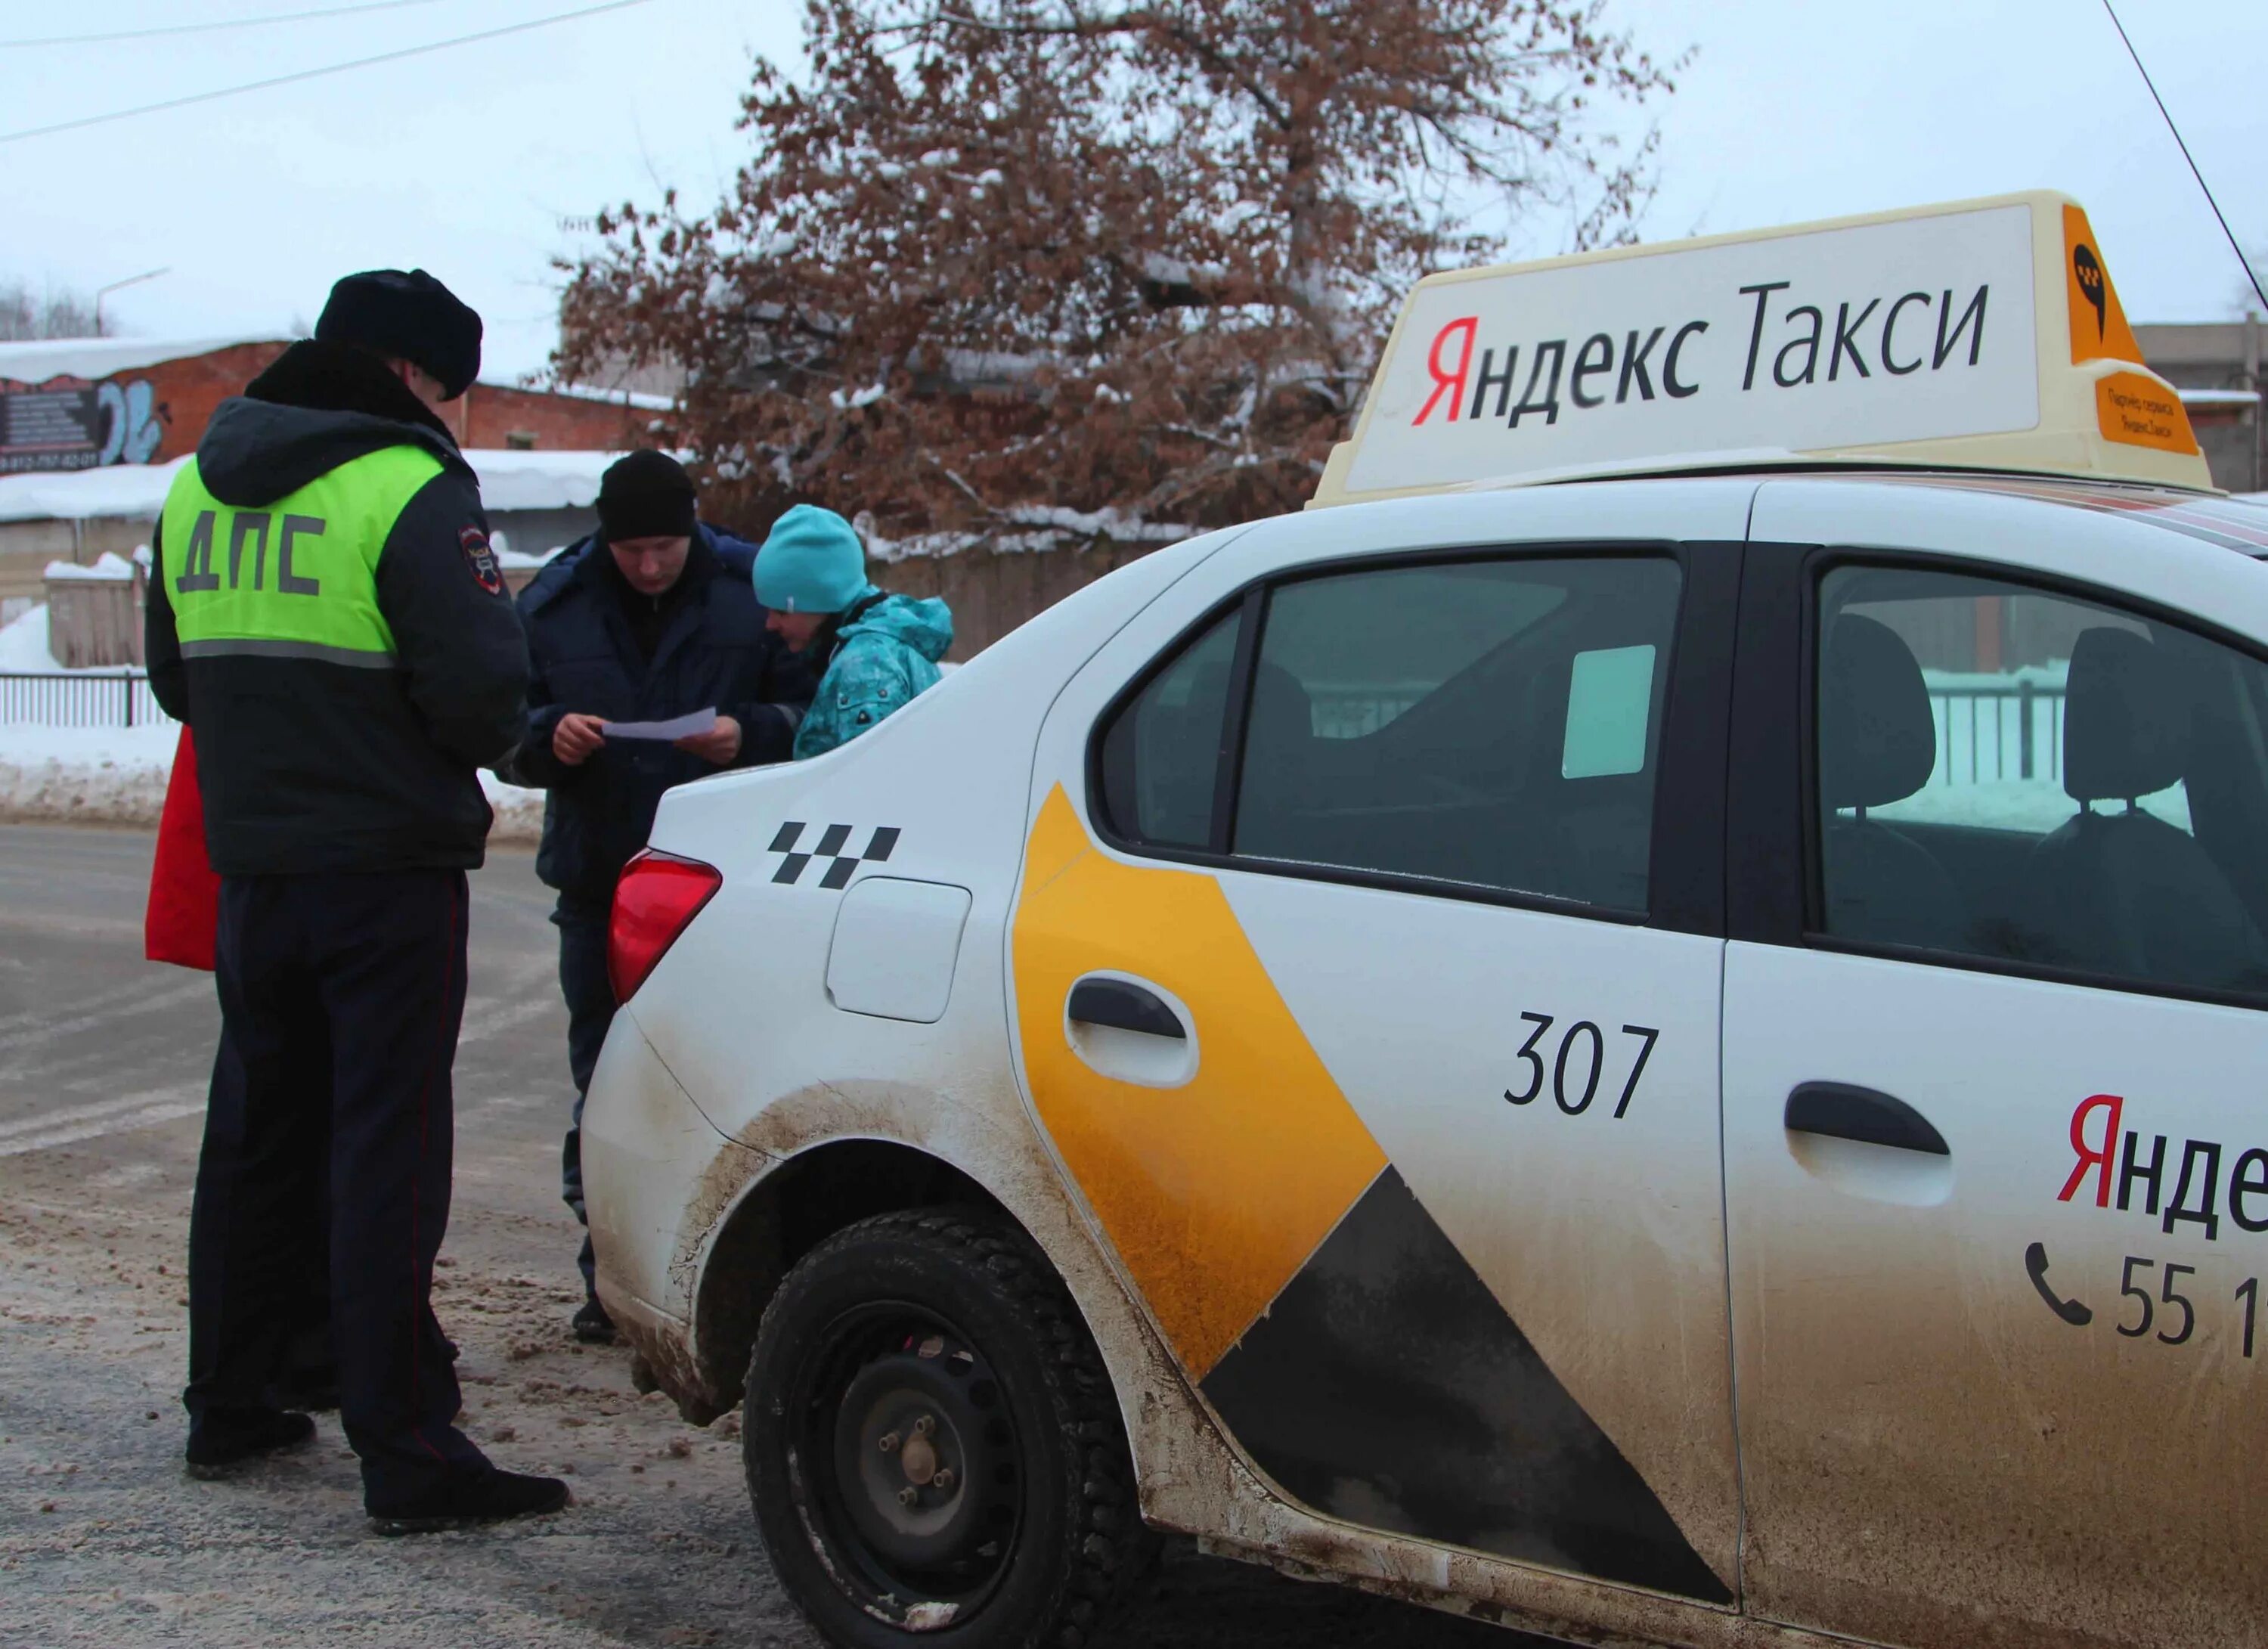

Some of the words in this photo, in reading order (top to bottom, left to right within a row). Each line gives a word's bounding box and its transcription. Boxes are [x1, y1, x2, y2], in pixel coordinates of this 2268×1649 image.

[1411, 316, 1709, 429] Яндекс
[1740, 281, 1990, 391] Такси
[175, 510, 326, 596] ДПС
[1504, 1011, 1659, 1119] 307
[2117, 1256, 2195, 1345] 55
[2235, 1277, 2268, 1358] 1
